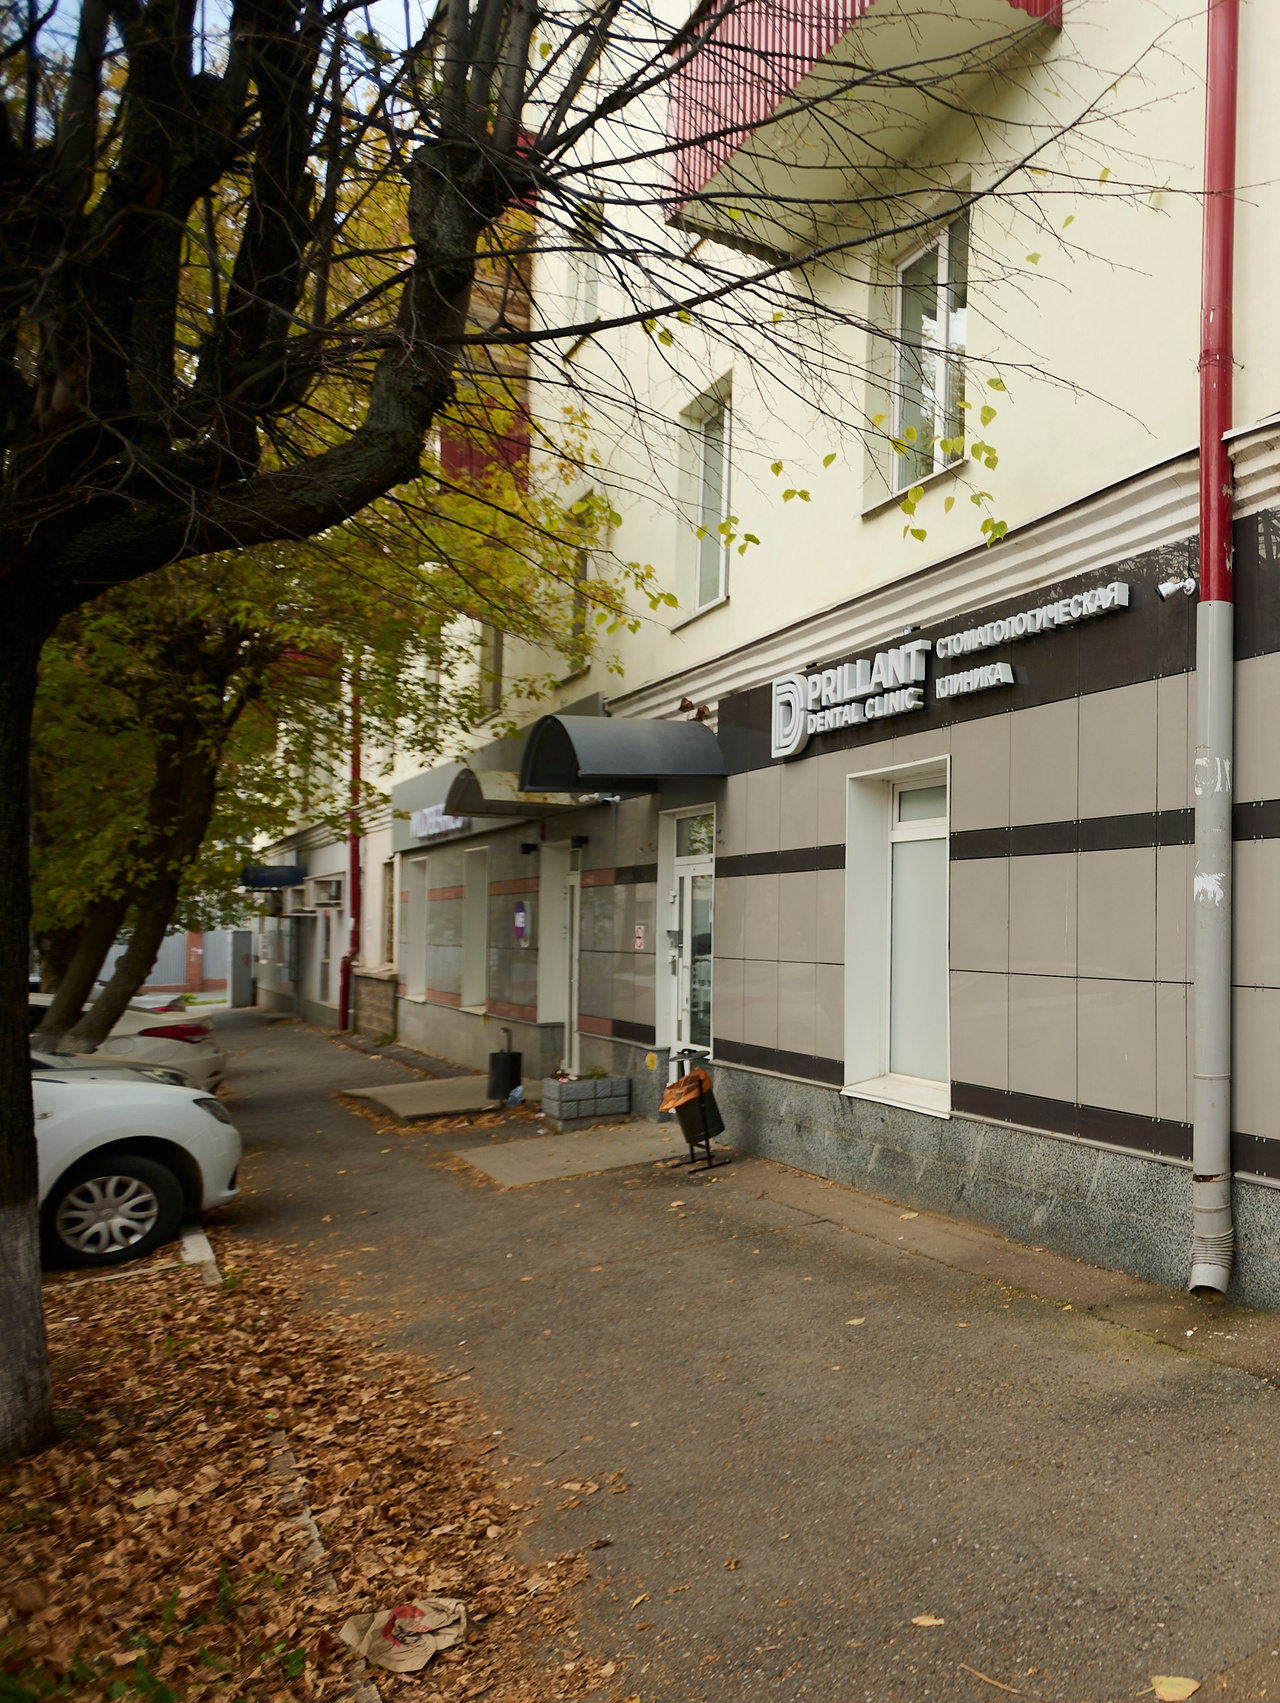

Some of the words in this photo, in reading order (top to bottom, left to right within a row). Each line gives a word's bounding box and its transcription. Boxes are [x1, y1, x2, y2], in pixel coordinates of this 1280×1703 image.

[936, 581, 1130, 659] СТОМАТОЛОГИЧЕСКАЯ
[807, 638, 932, 711] PRILLANT
[935, 661, 1014, 699] КЛИНИКА
[807, 702, 868, 735] DENTAL
[864, 687, 925, 719] CLINIC
